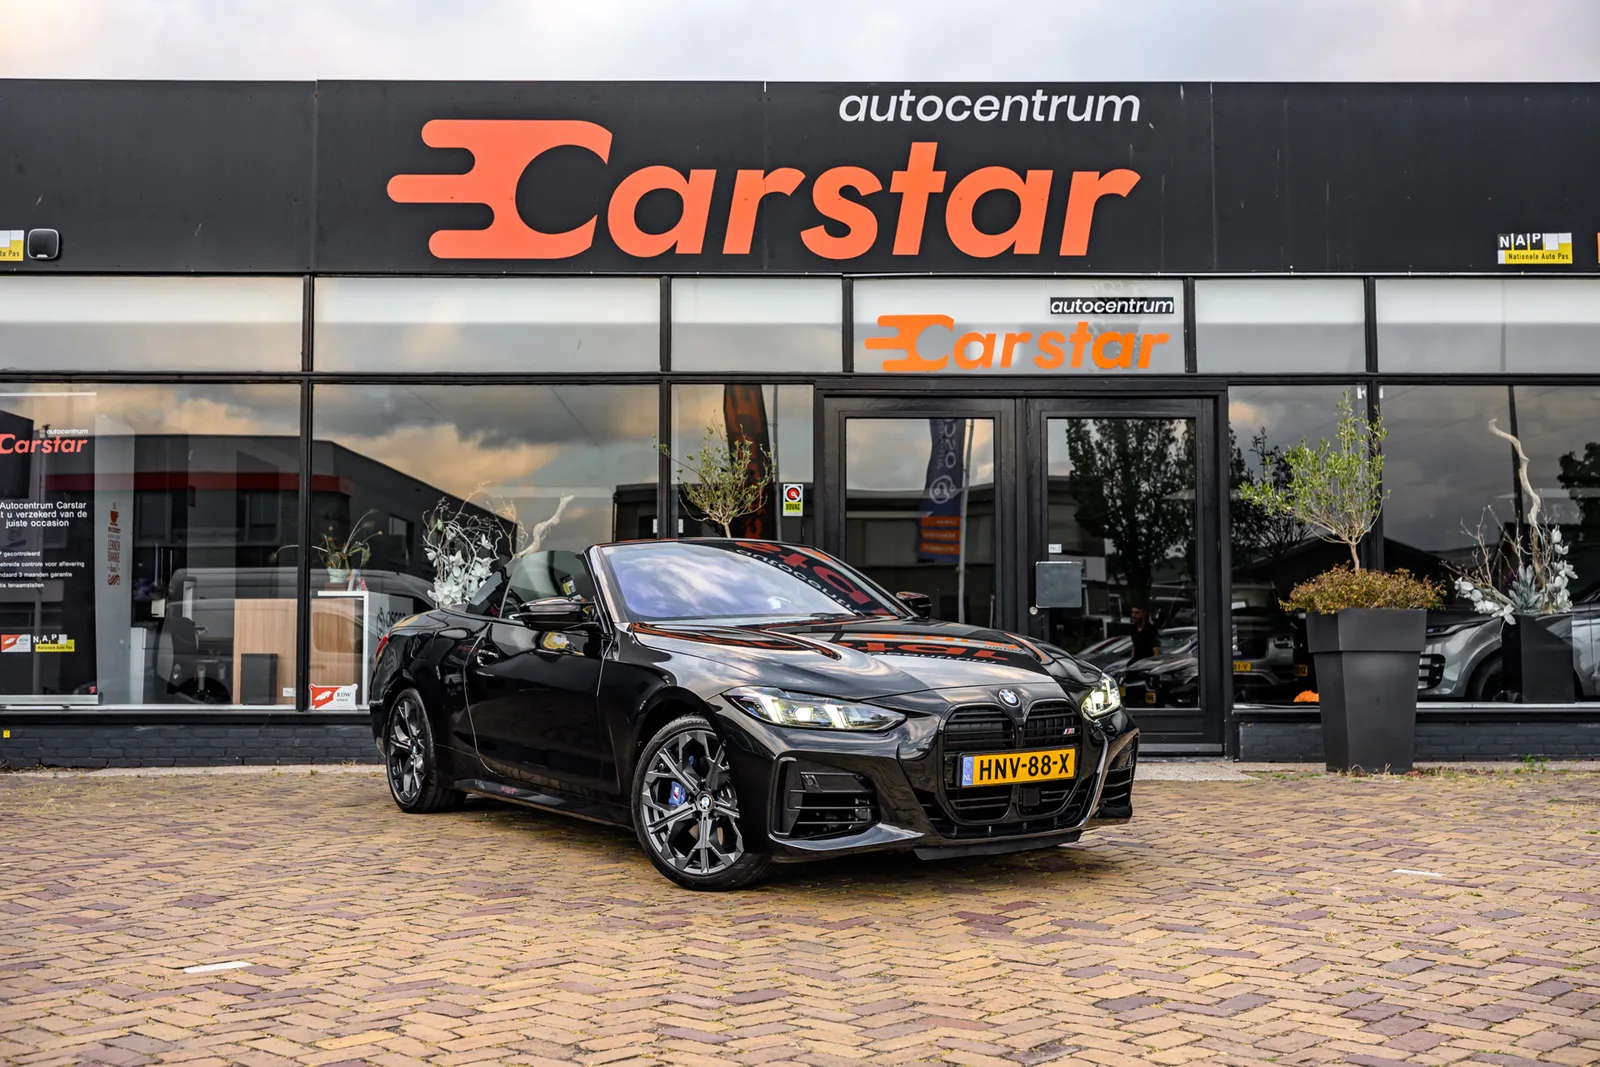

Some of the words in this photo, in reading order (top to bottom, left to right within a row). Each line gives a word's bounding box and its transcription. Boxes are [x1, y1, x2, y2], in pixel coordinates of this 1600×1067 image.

[838, 93, 1140, 123] autocentrum
[387, 119, 1141, 260] Carstar
[1508, 252, 1539, 260] Nationale
[1541, 252, 1556, 260] Auto
[1557, 252, 1569, 260] Pas
[1050, 297, 1175, 314] autocentrum
[864, 313, 1171, 372] Carstar
[56, 501, 87, 509] Carstar
[77, 510, 87, 518] de
[6, 520, 28, 529] juiste
[30, 519, 69, 527] occasion
[979, 753, 1070, 781] HNV-88-X
